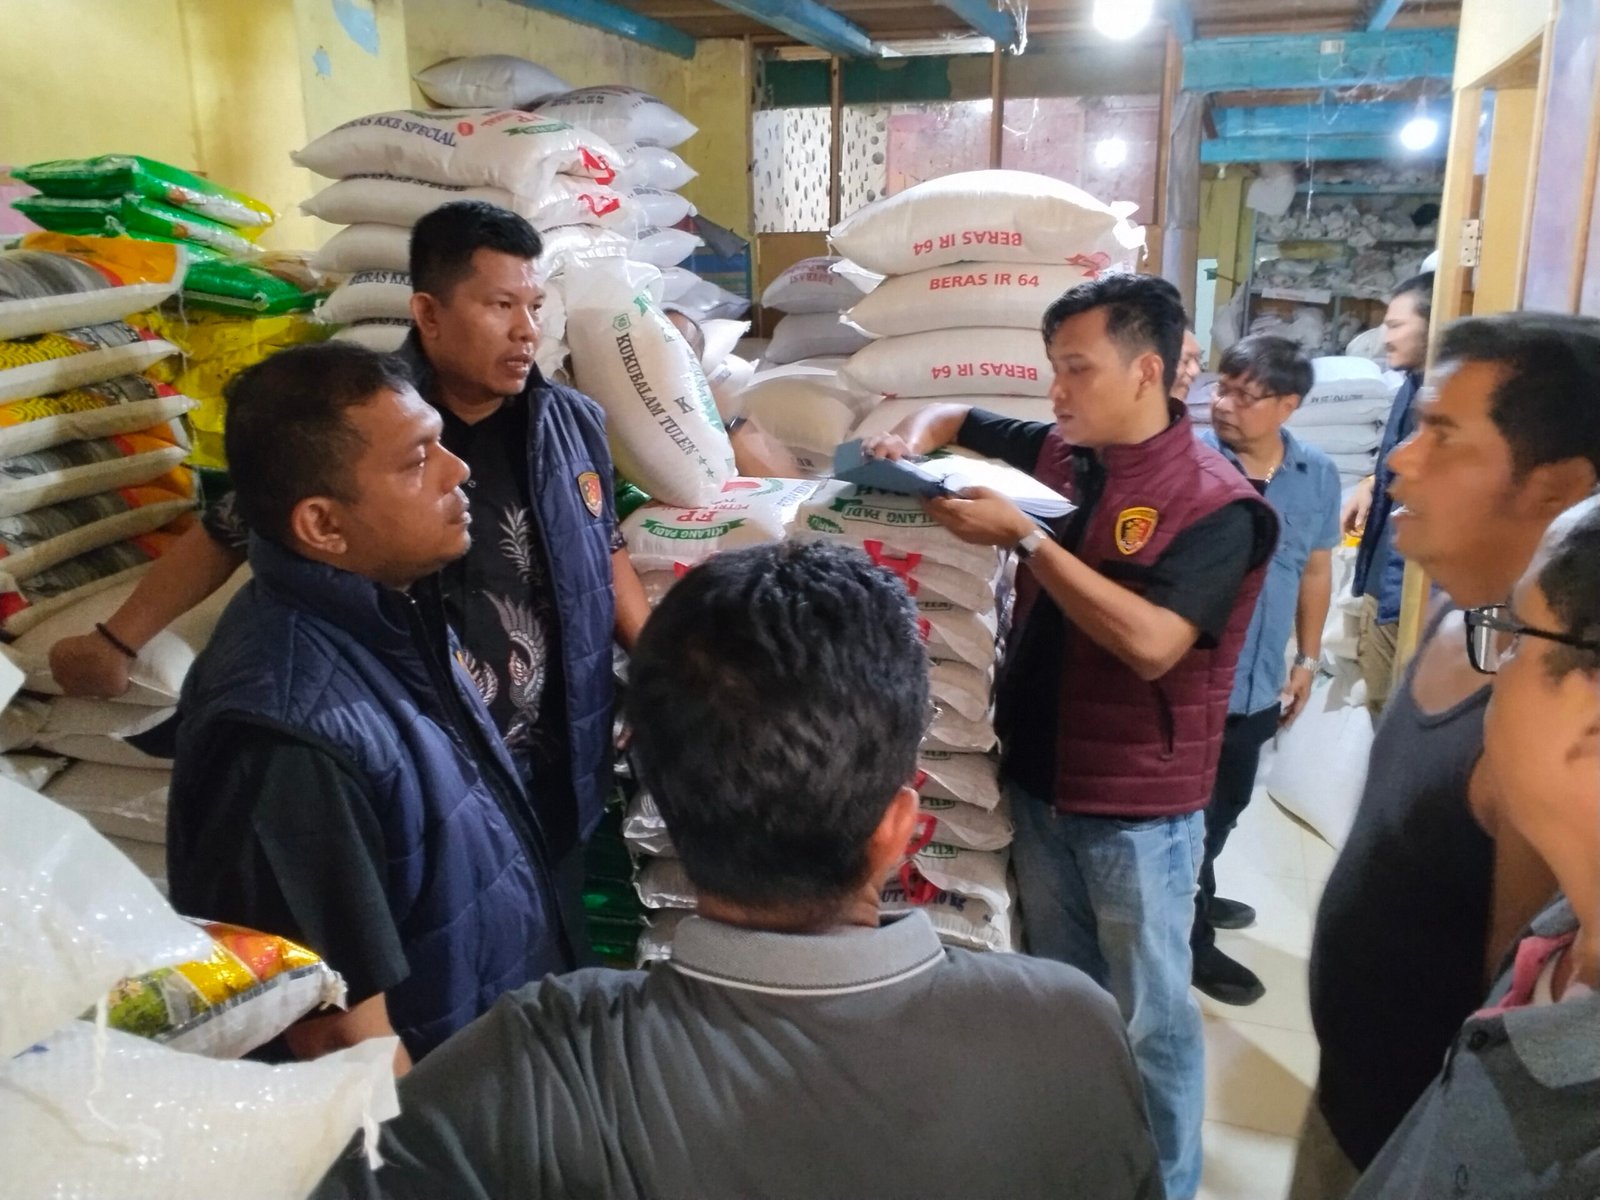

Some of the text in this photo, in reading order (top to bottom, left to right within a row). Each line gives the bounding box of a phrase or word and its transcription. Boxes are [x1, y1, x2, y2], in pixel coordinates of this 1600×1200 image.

[401, 121, 457, 147] SPECIAL
[913, 231, 1023, 256] BERAS IR 64
[929, 273, 1040, 290] BERAS IR 64
[931, 363, 1038, 381] BERAS IR 64
[616, 332, 667, 418] KUKUBALAM
[659, 415, 700, 456] TULEN
[846, 507, 880, 520] PADI
[652, 526, 725, 539] KILANG PADI
